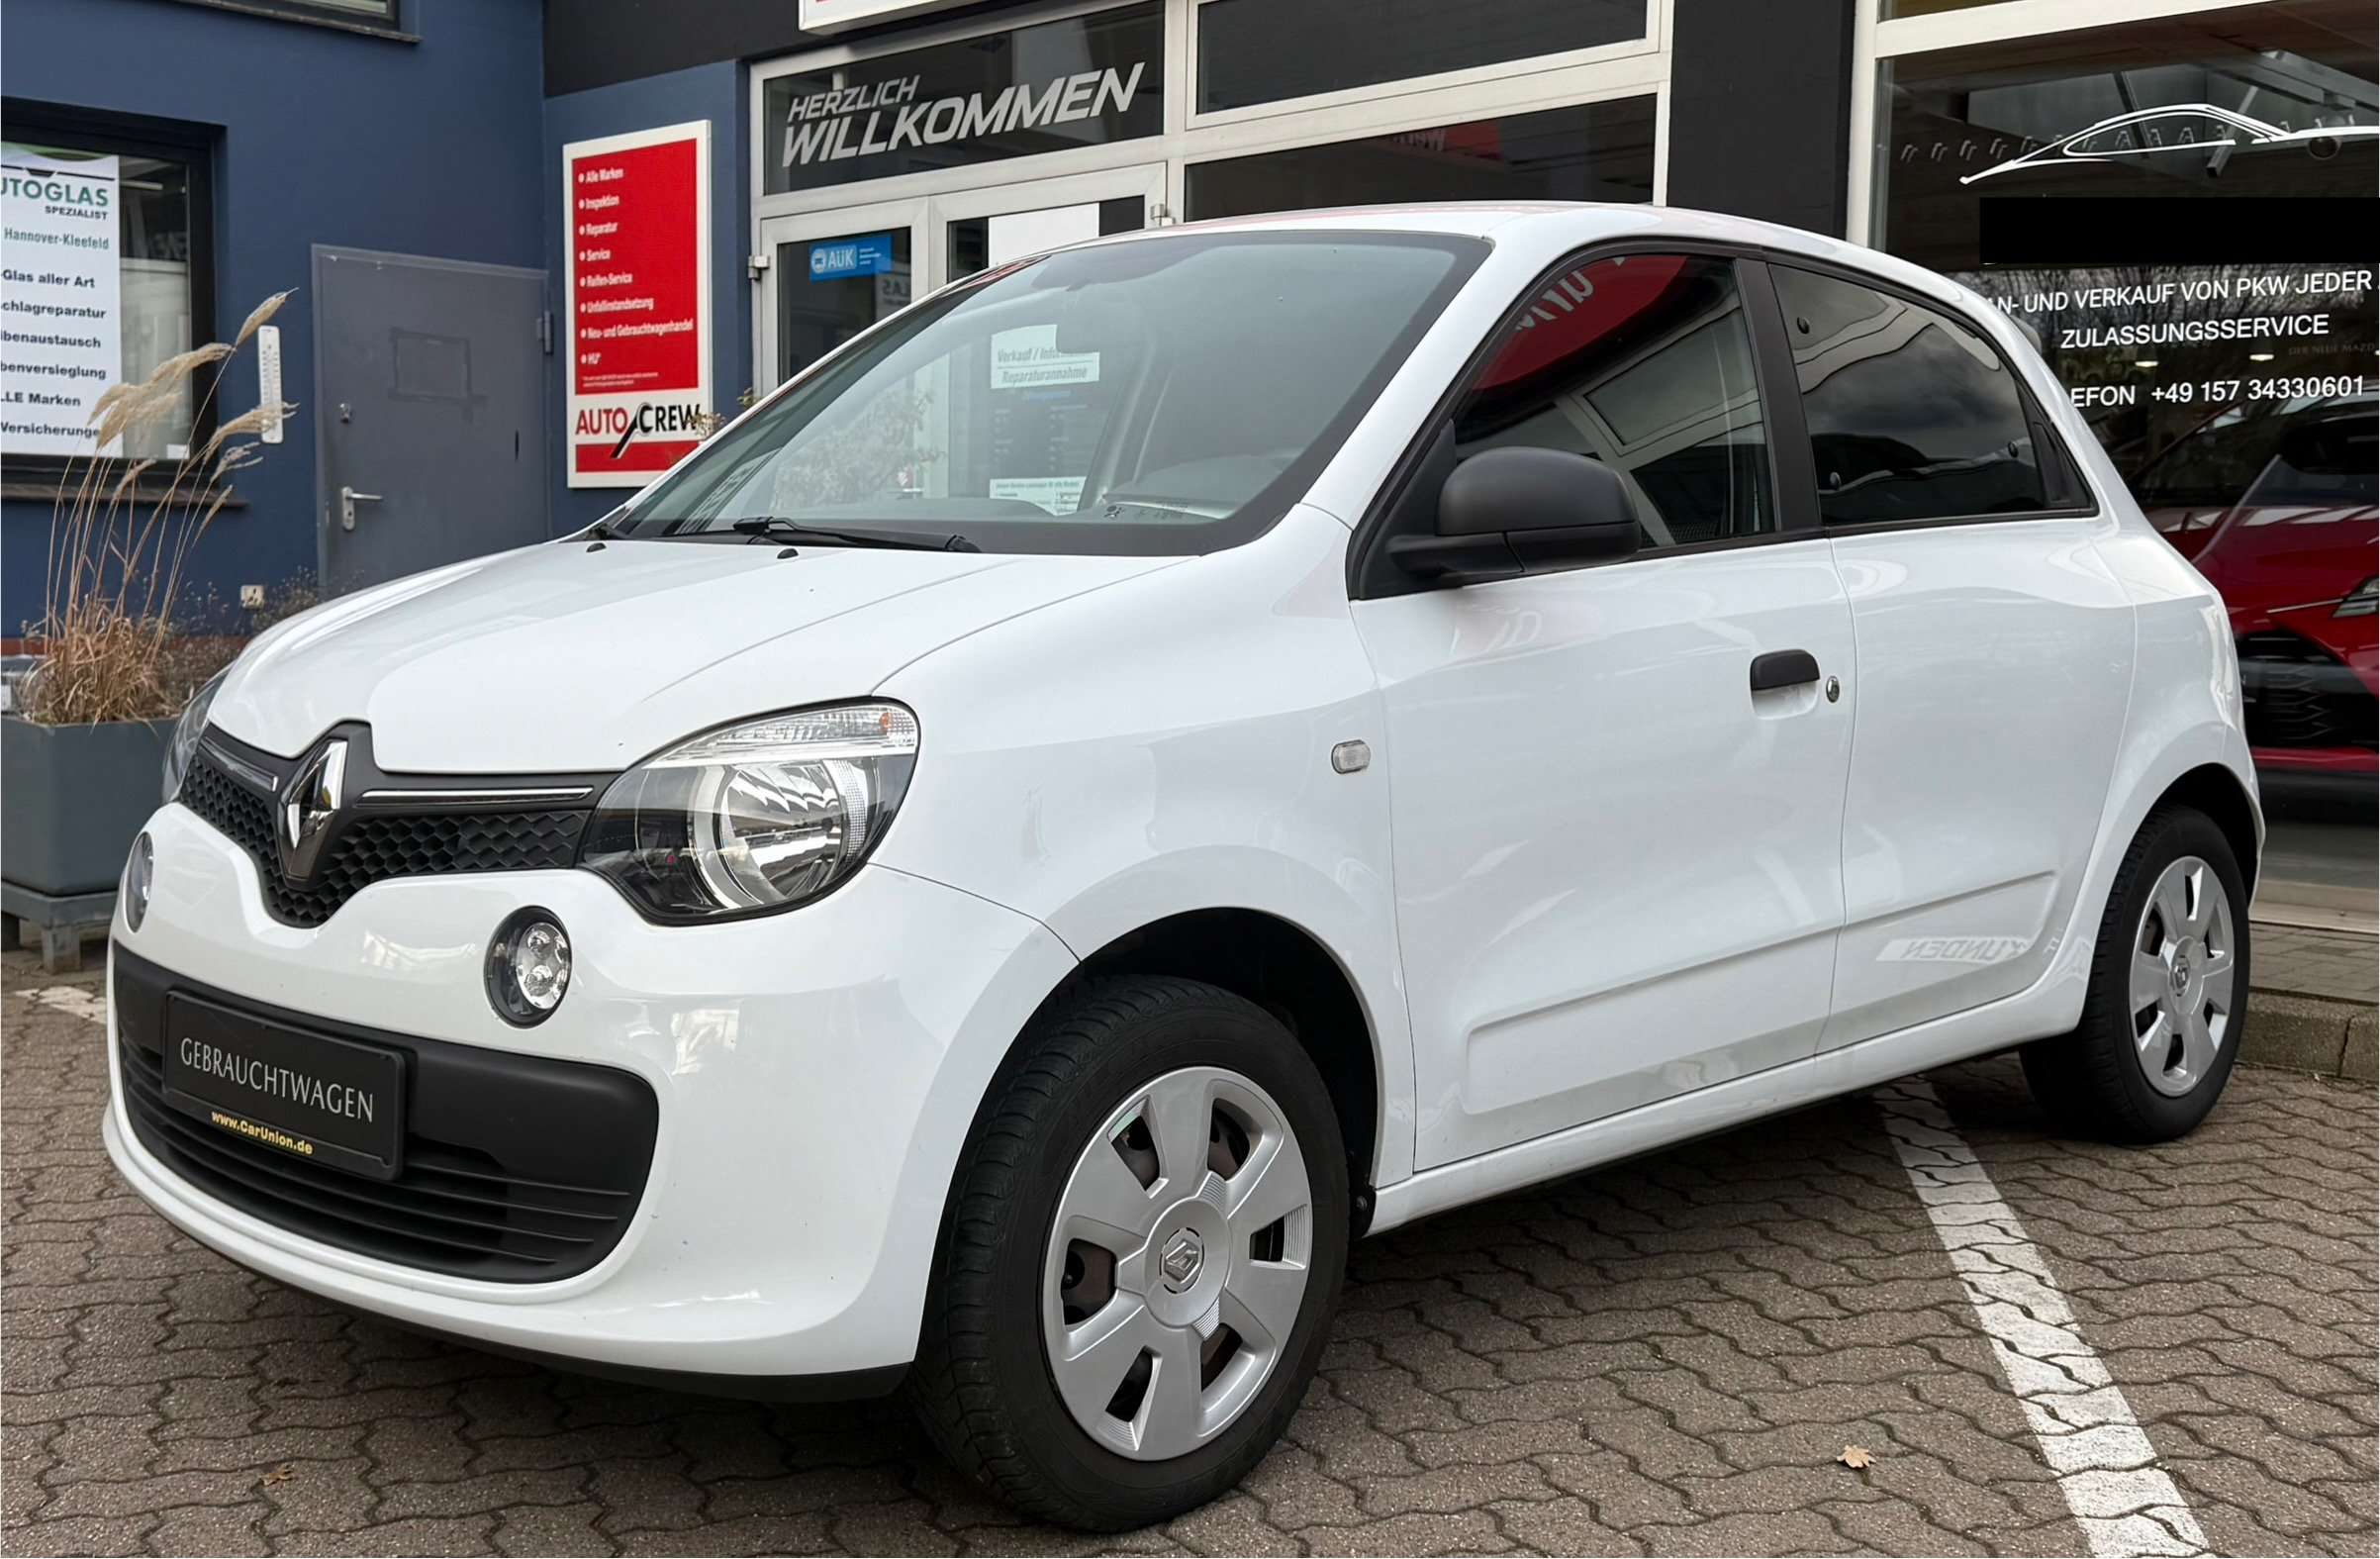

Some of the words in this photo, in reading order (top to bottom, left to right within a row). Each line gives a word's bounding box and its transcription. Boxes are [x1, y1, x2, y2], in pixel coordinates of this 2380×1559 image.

[788, 74, 920, 123] HERZLICH
[782, 61, 1146, 167] WILLKOMMEN
[45, 205, 109, 221] SPEZIALIST
[3, 227, 110, 250] Hannover-Kleefeld
[586, 247, 611, 261] Service
[827, 245, 856, 269] AUK
[1, 268, 34, 283] Glas
[38, 272, 69, 286] aller
[74, 275, 96, 289] Art
[2024, 292, 2069, 313] UND
[2074, 282, 2176, 310] VERKAUF
[2180, 278, 2229, 303] VON
[2236, 275, 2291, 298] PKW
[2295, 270, 2373, 295] JEDER
[1, 300, 107, 320] chlagreparatur
[2060, 314, 2330, 349] ZULASSUNGSSERVICE
[1001, 366, 1088, 386] Reparaturannahme
[1, 391, 24, 405] LE
[28, 393, 82, 408] Marken
[2150, 382, 2193, 405] +49
[2200, 380, 2240, 403] 157
[2247, 375, 2363, 401] 34330601
[1, 421, 102, 439] Versicherunge
[575, 407, 629, 436] AUTO
[638, 404, 701, 434] CREW
[180, 1036, 374, 1124] GEBRAUCHTWAGEN
[210, 1110, 315, 1156] www.CarUnion.de
